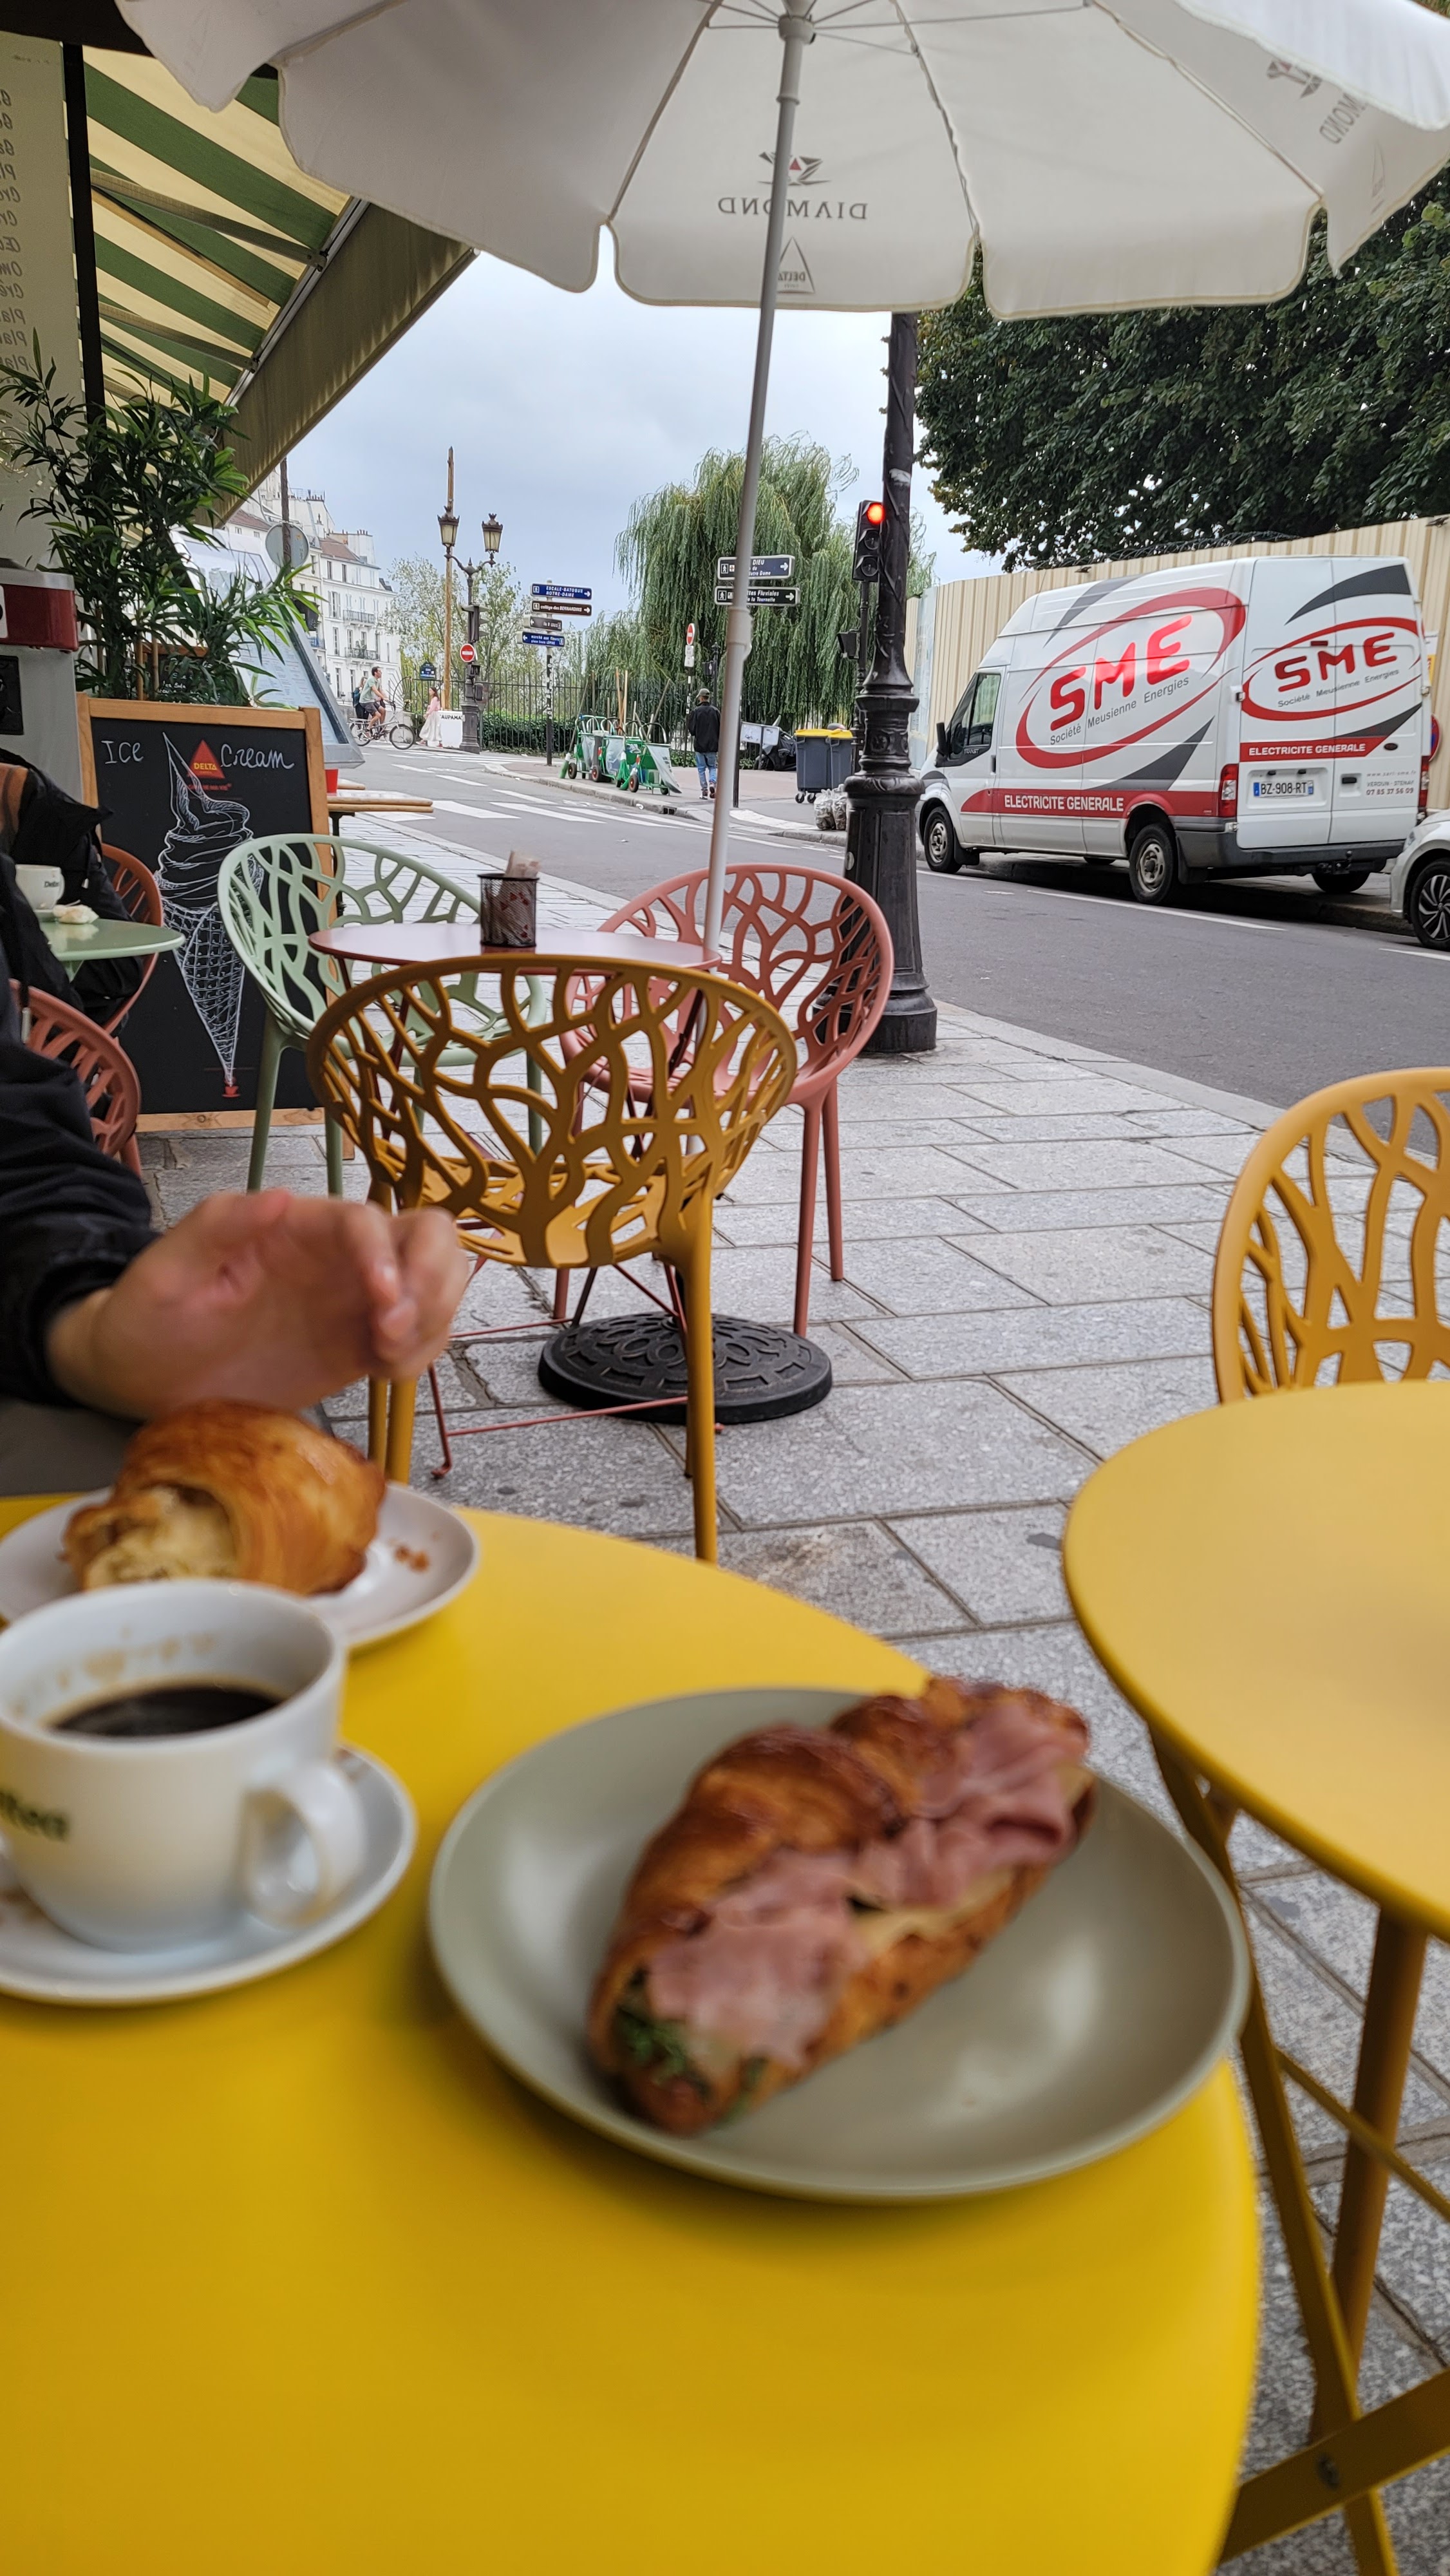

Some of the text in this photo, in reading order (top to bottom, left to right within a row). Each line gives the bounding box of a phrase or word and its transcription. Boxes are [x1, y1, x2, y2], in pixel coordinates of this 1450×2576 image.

[1050, 614, 1192, 731] SME
[1275, 632, 1397, 692] SME
[1278, 669, 1400, 707] Société Meusienne Energies
[1050, 676, 1189, 745] Société Meusienne Energies
[101, 740, 295, 770] Ice Cream
[1249, 743, 1366, 755] ELECTRICITE GENERALE
[1004, 795, 1124, 812] ELECTRICITE GENERALE
[1261, 782, 1306, 795] BZ-908-RT
